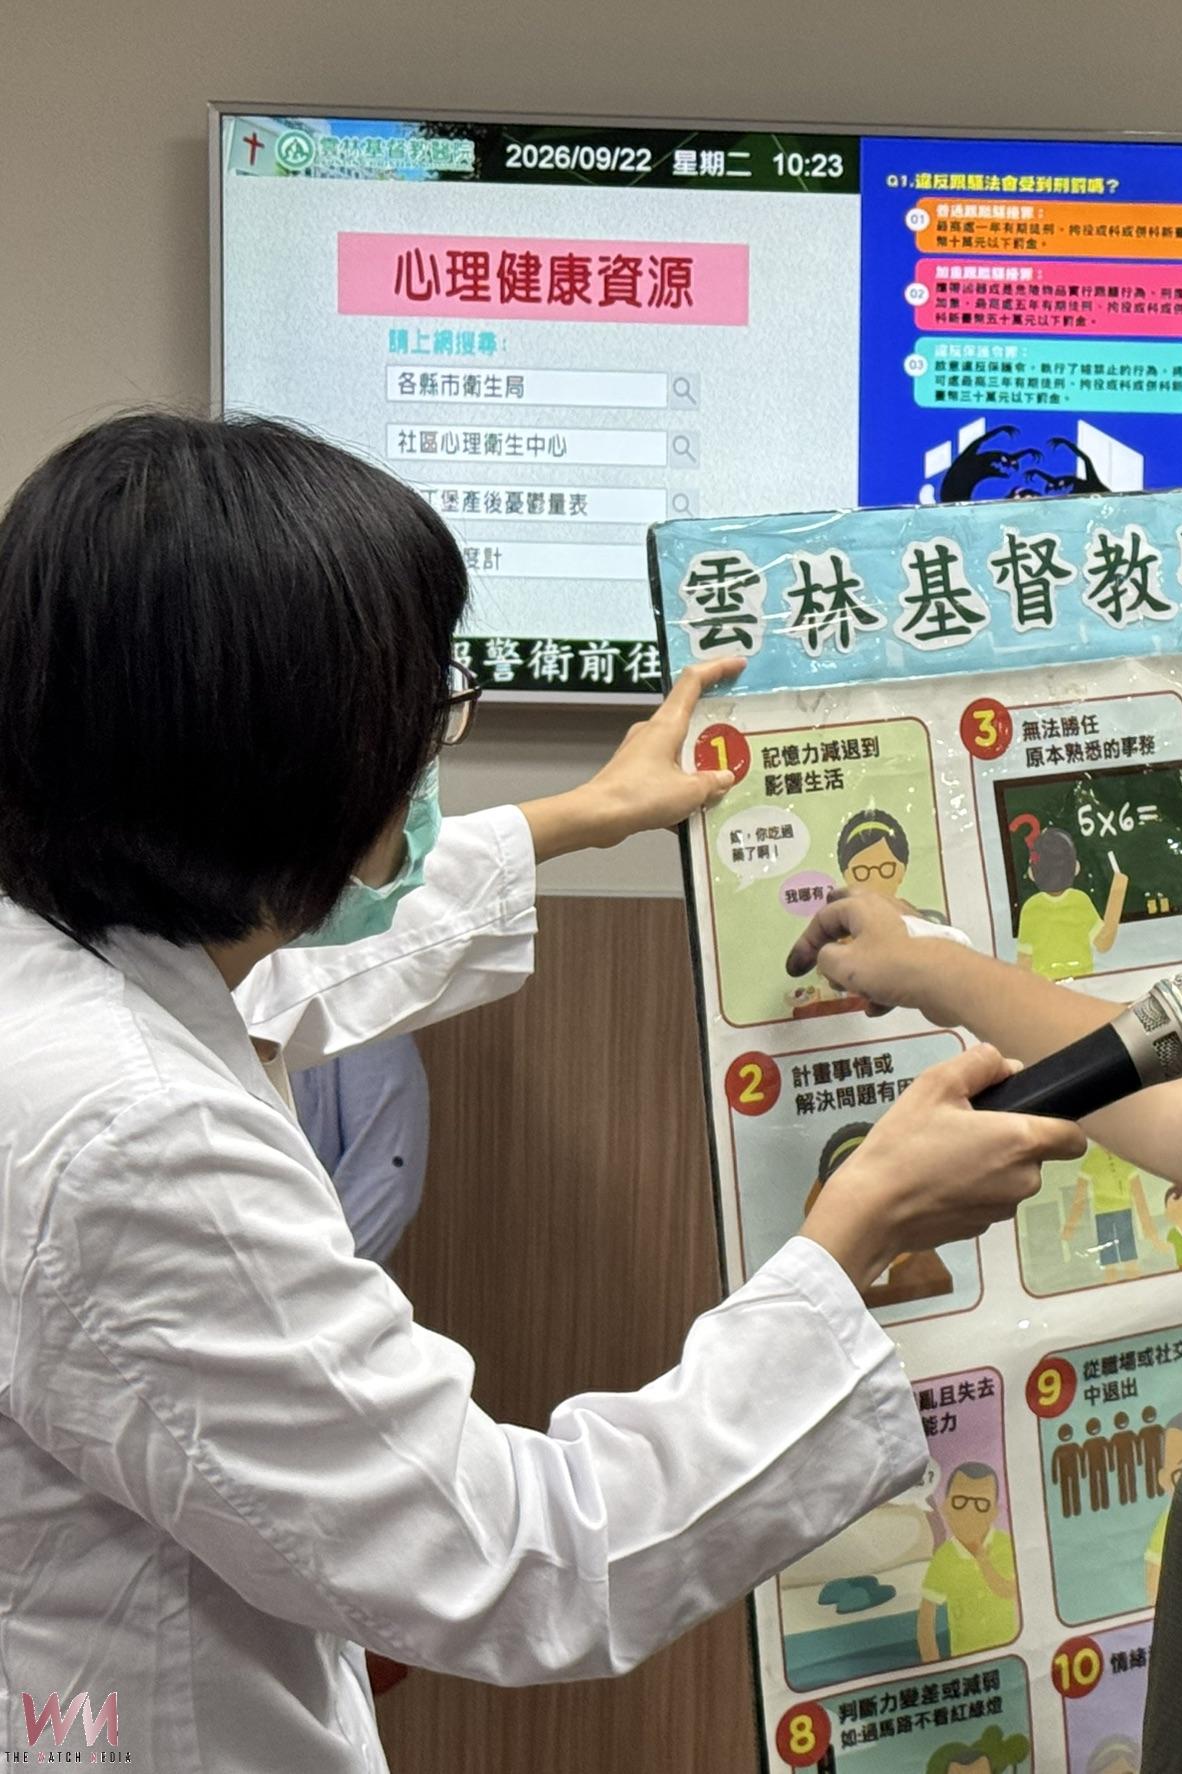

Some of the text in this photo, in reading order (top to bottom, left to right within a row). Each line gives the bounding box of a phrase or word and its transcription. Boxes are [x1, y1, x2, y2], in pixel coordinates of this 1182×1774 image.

[506, 144, 844, 178] 2026/09/22 星期二 10:23
[910, 214, 925, 225] 01
[394, 248, 694, 309] 心理健康資源
[909, 288, 925, 299] 02
[909, 359, 924, 371] 03
[398, 372, 525, 399] 各縣市衛生局
[398, 430, 567, 457] 社區心理衛生中心
[973, 710, 997, 747] 3
[1022, 714, 1100, 742] 無法勝任
[711, 736, 728, 771] 1
[761, 736, 880, 769] 記憶力減退到
[1026, 735, 1155, 768] 原本熟悉的事務
[765, 768, 844, 797] 影響生活
[739, 1064, 764, 1103] 2
[792, 1053, 894, 1088] 計畫事情或
[914, 1377, 995, 1411] 亂且失去
[1037, 1369, 1063, 1406] 9
[1084, 1377, 1138, 1407] 中退出
[1054, 1647, 1100, 1690] 10
[1110, 1646, 1152, 1674] 情緒
[839, 1669, 1000, 1724] 判斷力變差或減弱
[789, 1715, 816, 1754] 8
